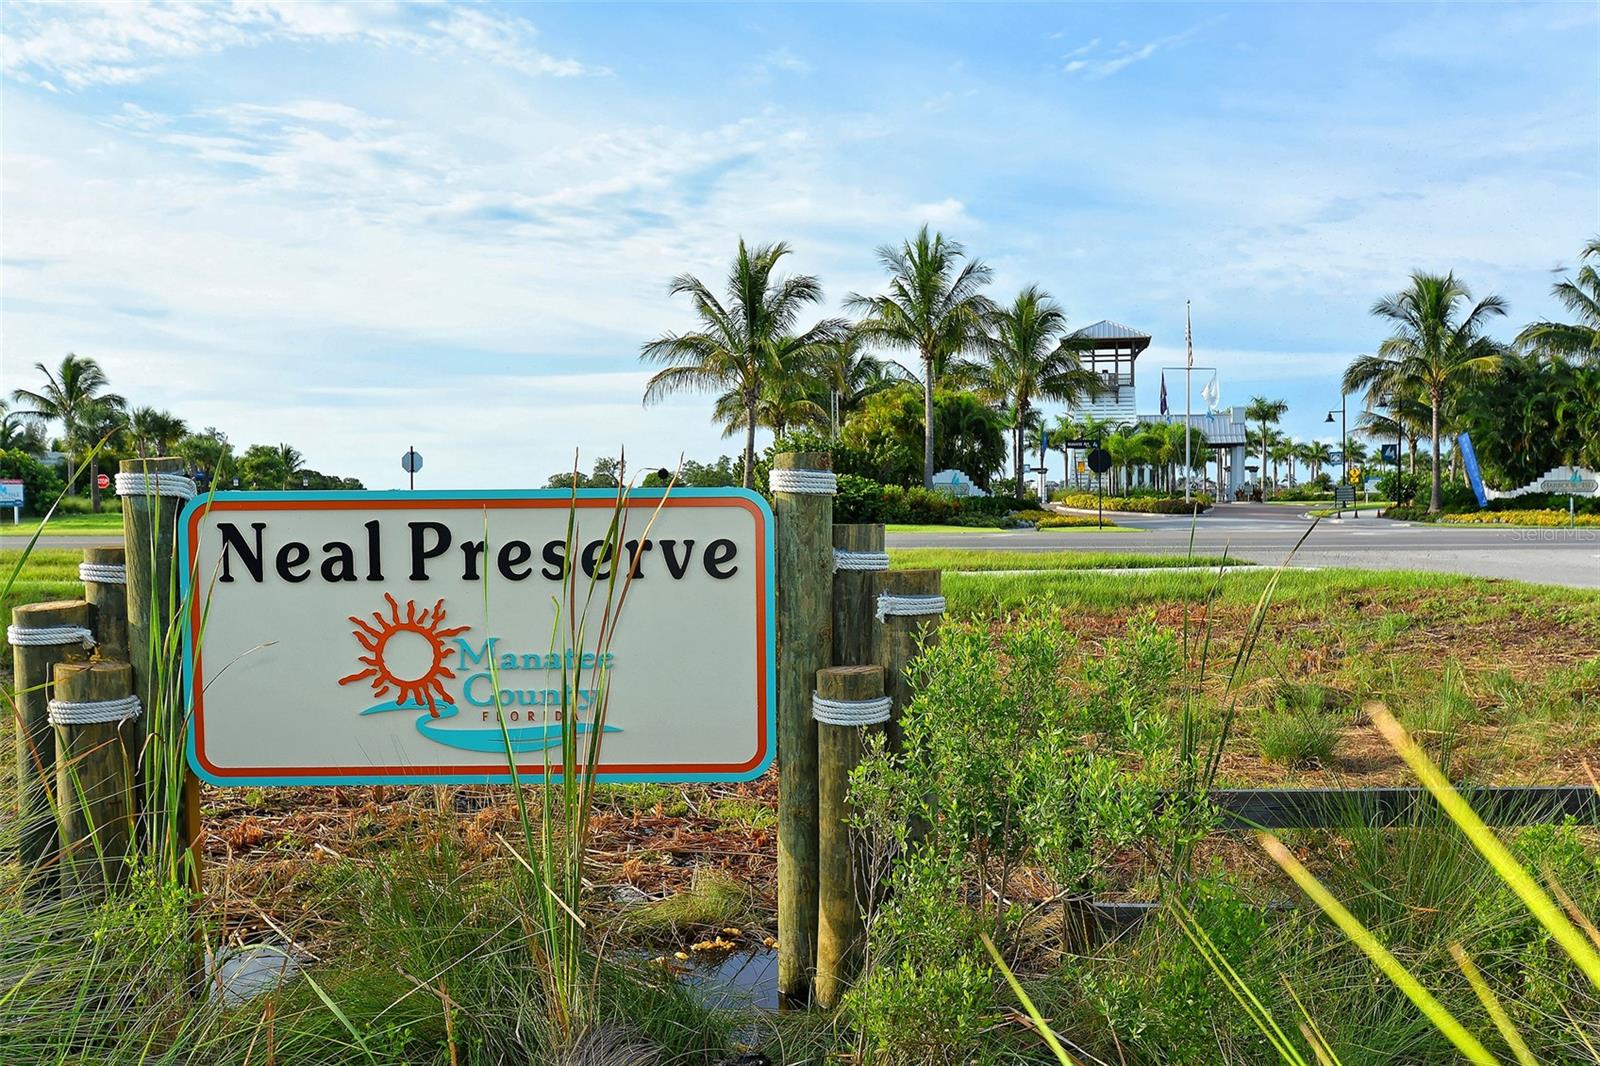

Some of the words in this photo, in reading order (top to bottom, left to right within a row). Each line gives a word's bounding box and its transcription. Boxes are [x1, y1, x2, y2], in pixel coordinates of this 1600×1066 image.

[216, 520, 385, 583] Neal
[407, 521, 738, 581] Preserve
[453, 637, 615, 671] Manatee
[463, 672, 600, 711] County
